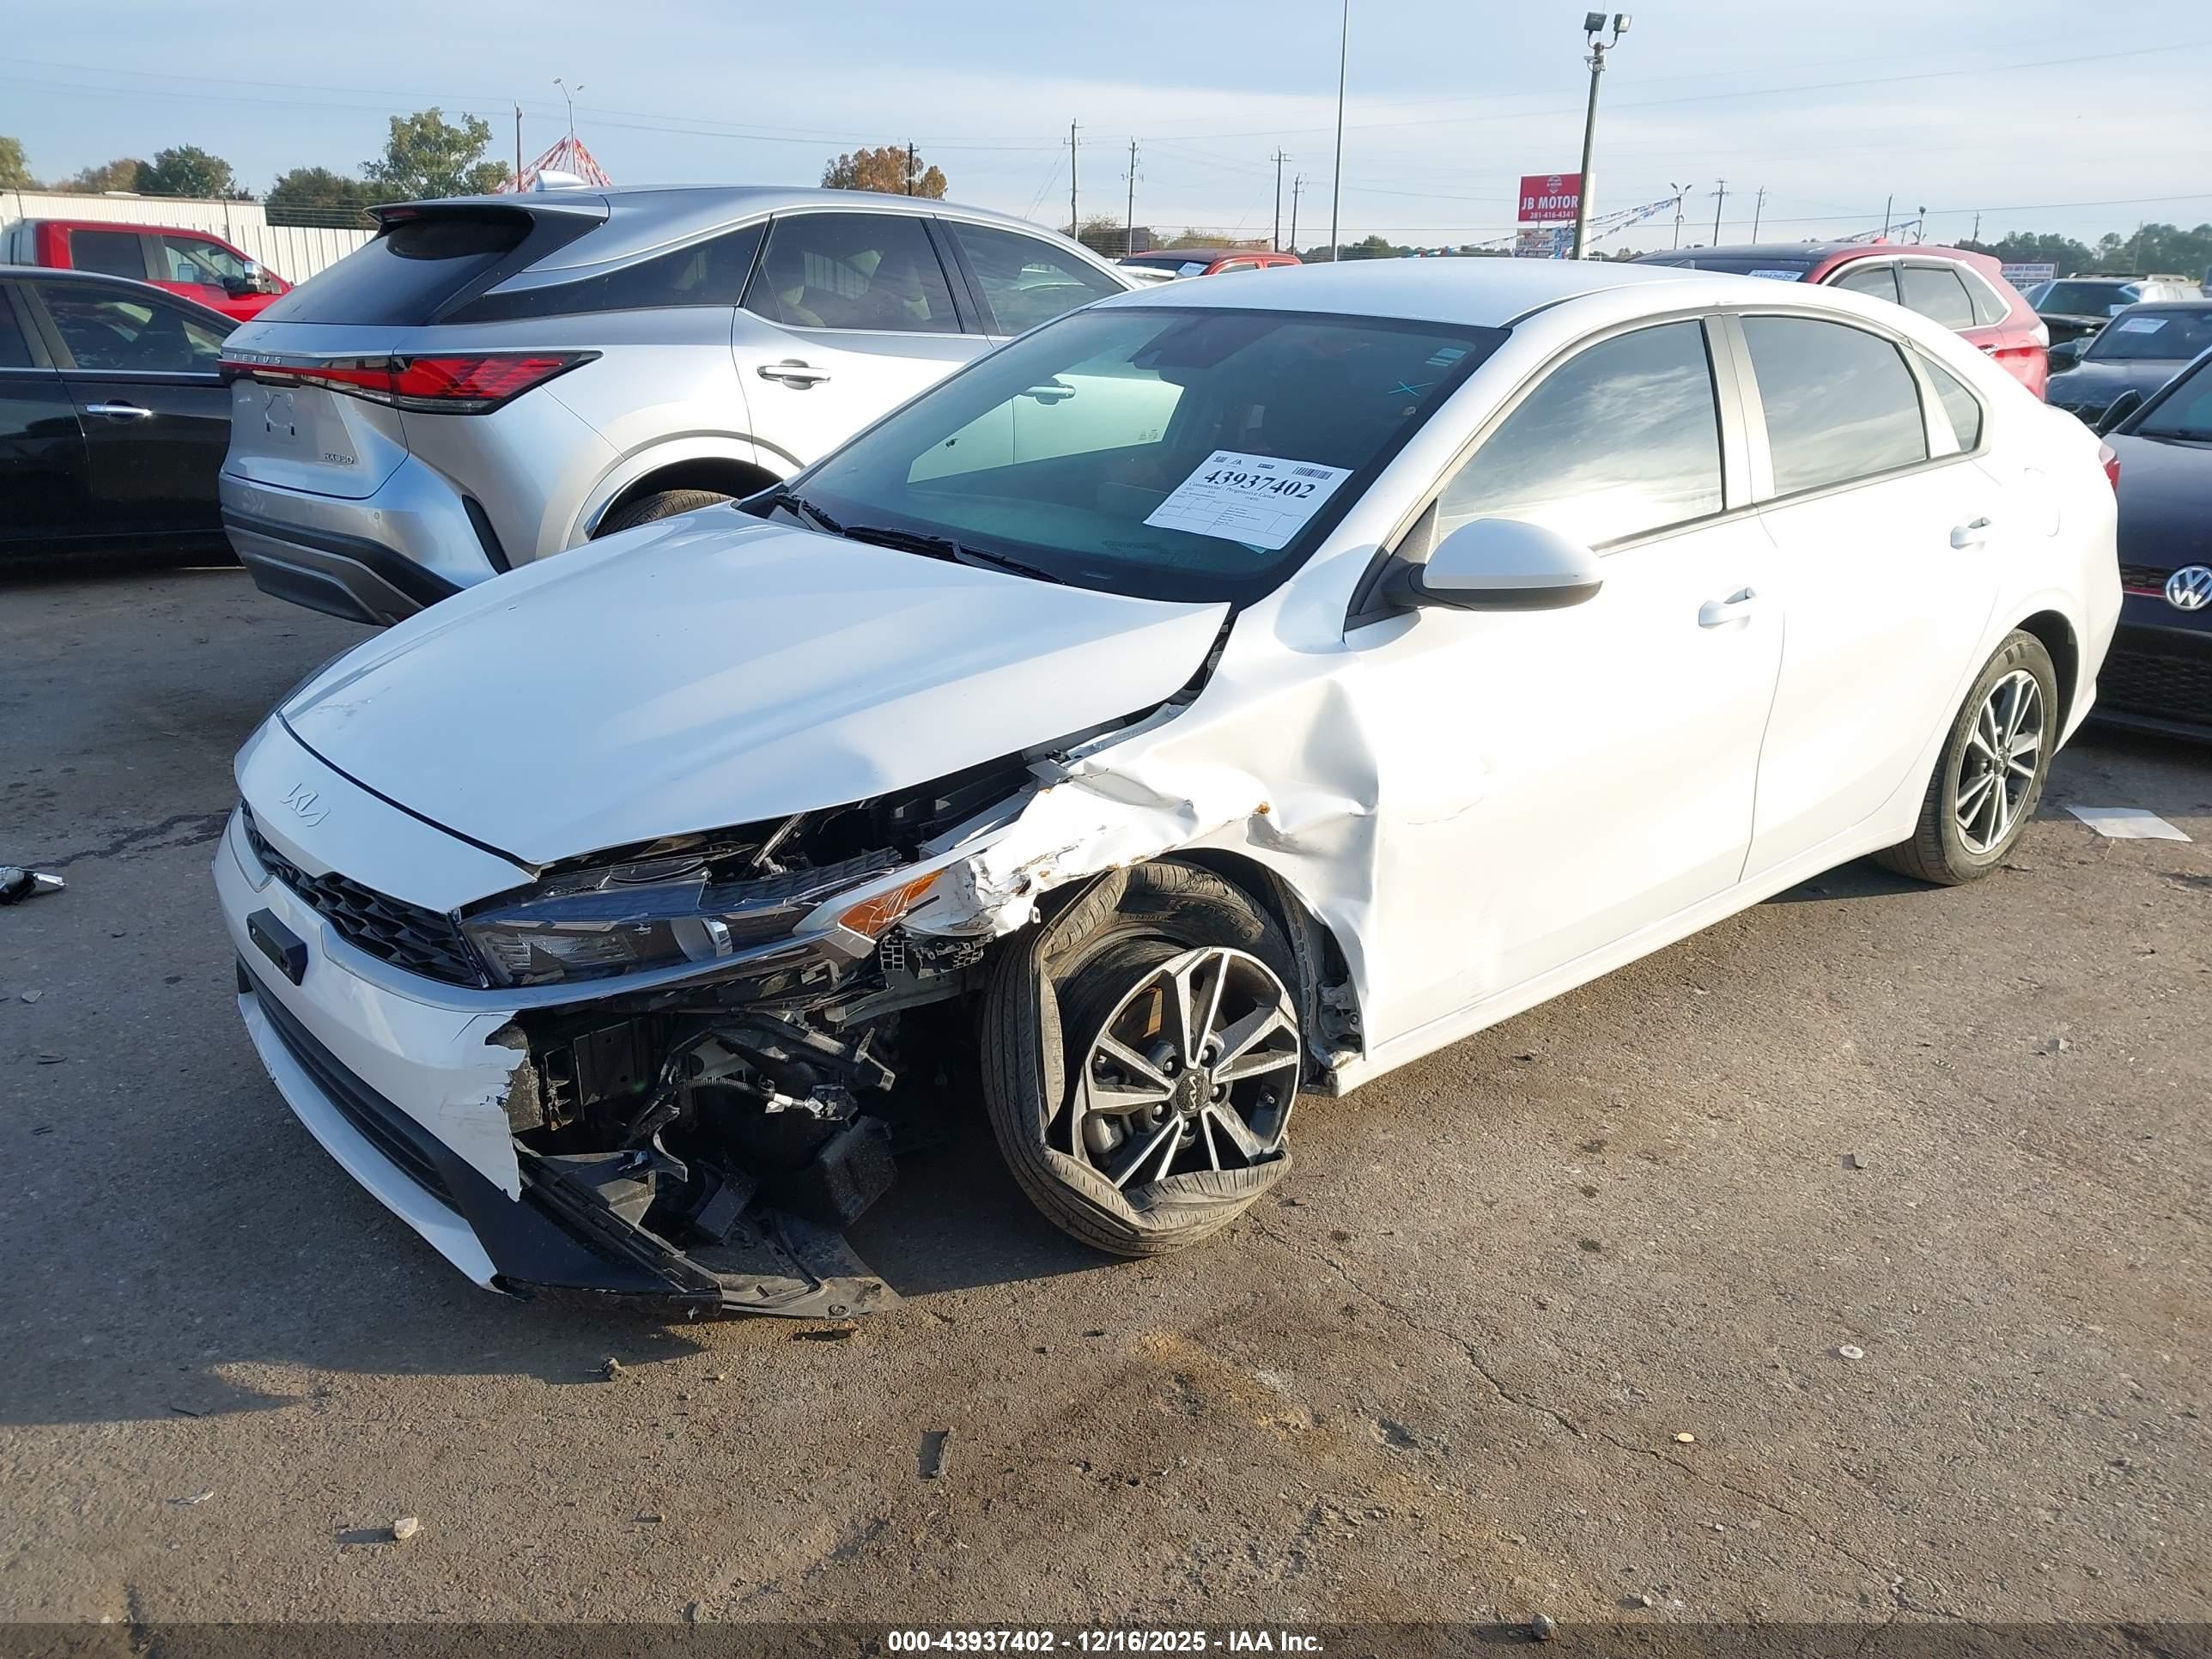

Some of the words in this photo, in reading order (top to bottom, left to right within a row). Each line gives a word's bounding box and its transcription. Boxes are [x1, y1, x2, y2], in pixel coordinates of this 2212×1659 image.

[1522, 197, 1534, 210] JB
[1538, 195, 1578, 209] MOTOR
[234, 353, 282, 364] LEXUS
[1203, 469, 1317, 499] 43937402
